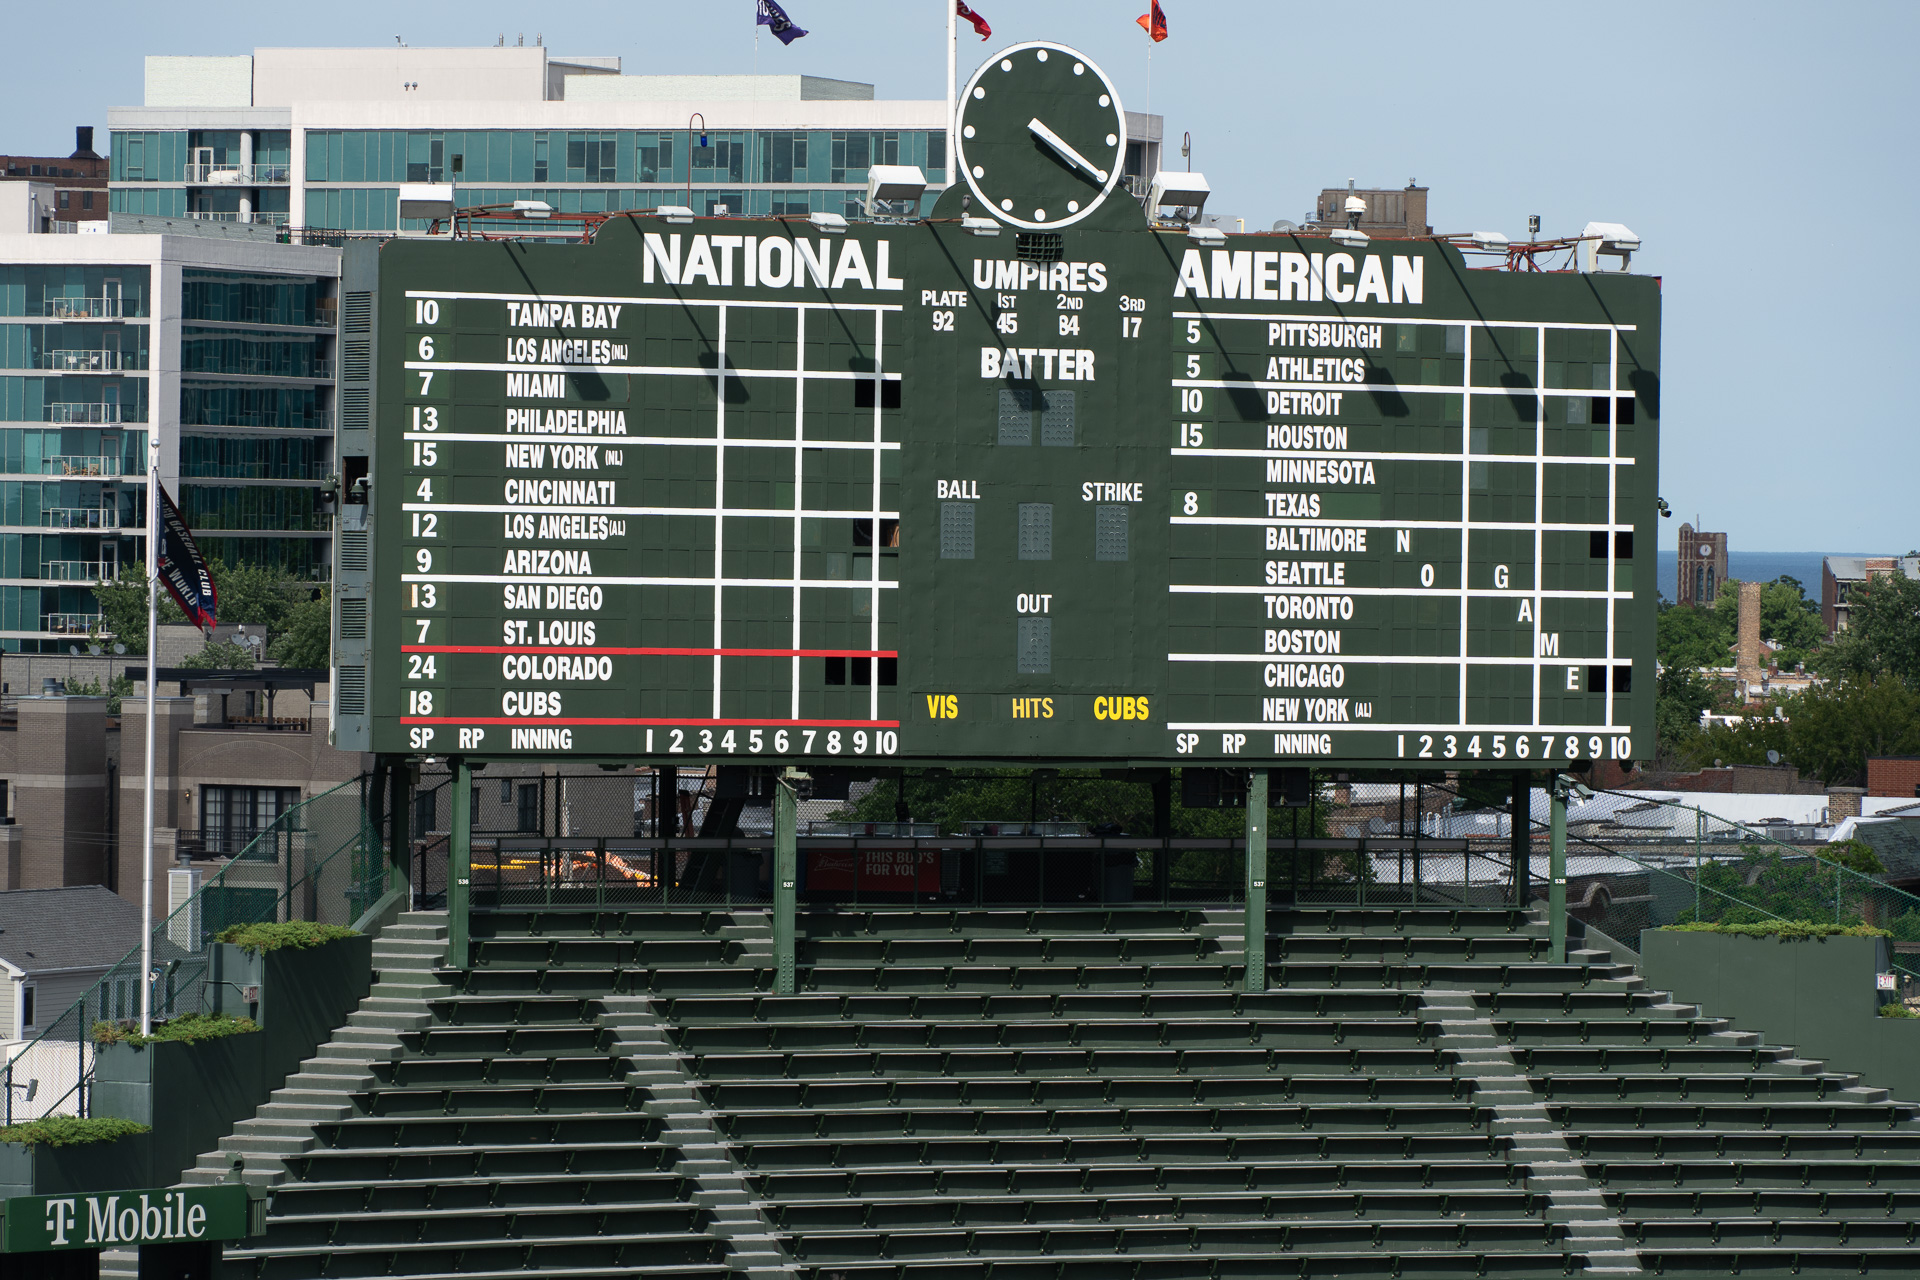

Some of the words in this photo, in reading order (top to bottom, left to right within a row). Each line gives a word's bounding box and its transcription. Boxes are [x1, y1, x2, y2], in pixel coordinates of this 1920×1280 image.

[643, 234, 904, 291] NATIONAL
[973, 258, 1108, 293] UMPIRES
[1174, 249, 1424, 305] AMERICAN
[921, 289, 968, 308] PLATE
[997, 291, 1017, 309] 1ST
[1056, 293, 1084, 310] 2ND
[1118, 294, 1146, 312] 3RD
[415, 299, 440, 325] 10
[506, 301, 577, 329] TAMPA
[581, 303, 622, 329] BAY
[932, 310, 955, 332] 92
[996, 312, 1018, 334] 45
[1058, 314, 1081, 336] 84
[1122, 316, 1143, 339] 17
[1186, 319, 1202, 344] 5
[1268, 322, 1383, 349] PITTSBURGH
[418, 335, 435, 361] 6
[506, 337, 538, 363] LOS
[539, 338, 611, 365] ANGELES
[980, 346, 1096, 381] BATTER
[1185, 354, 1201, 379] 5
[1265, 356, 1366, 383] ATHLETICS
[418, 371, 434, 396] 7
[506, 372, 566, 399] MIAMI
[1181, 388, 1204, 414] 10
[1267, 390, 1343, 417] DETROIT
[412, 406, 439, 432] 13
[506, 408, 628, 435] PHILADELPHIA
[1180, 422, 1204, 448] 15
[1266, 424, 1348, 451] HOUSTON
[412, 441, 438, 467] 15
[505, 443, 546, 469] NEW
[548, 444, 599, 470] YORK
[1266, 458, 1376, 485] MINNESOTA
[416, 477, 434, 502] 4
[504, 478, 616, 505] CINCINNATI
[937, 479, 981, 500] BALL
[1081, 481, 1143, 502] STRIKE
[1183, 491, 1199, 516] 8
[1264, 492, 1321, 518] TEXAS
[411, 512, 438, 538] 12
[504, 513, 535, 540] LOS
[537, 514, 609, 541] ANGELES
[1265, 526, 1368, 553] BALTIMORE
[1396, 529, 1411, 553] N
[415, 548, 433, 573] 9
[502, 549, 593, 575] ARIZONA
[1265, 560, 1346, 586] SEATTLE
[197, 568, 212, 597] CLUB
[1494, 564, 1510, 589] G
[410, 583, 437, 609] 13
[503, 583, 541, 610] SAN
[545, 585, 603, 611] DIEGO
[1016, 592, 1053, 614] OUT
[1263, 594, 1354, 621] TORONTO
[1517, 598, 1534, 623] A
[415, 618, 431, 644] 7
[503, 619, 533, 646] ST.
[538, 619, 596, 646] LOUIS
[1264, 628, 1341, 654] BOSTON
[1540, 632, 1559, 657] M
[407, 654, 437, 680] 24
[502, 654, 613, 682] COLORADO
[1263, 662, 1345, 689] CHICAGO
[1566, 666, 1580, 691] E
[409, 690, 434, 716] 18
[501, 690, 562, 717] CUBS
[926, 694, 959, 720] VIS
[1012, 696, 1054, 719] HITS
[1093, 695, 1150, 721] CUBS
[1262, 697, 1301, 722] NEW
[1303, 697, 1350, 723] YORK
[409, 727, 435, 749] SP
[458, 727, 485, 750] RP
[511, 728, 573, 750] INNING
[645, 728, 654, 753] 1
[668, 728, 684, 753] 2
[697, 728, 714, 754] 3
[720, 729, 737, 754] 4
[748, 729, 764, 754] 5
[774, 729, 790, 754] 6
[802, 729, 817, 754] 7
[826, 730, 842, 755] 8
[852, 730, 868, 755] 9
[875, 730, 898, 756] 10
[1176, 732, 1200, 754] SP
[1222, 733, 1247, 754] RP
[1274, 733, 1332, 755] INNING
[1397, 734, 1405, 758] 1
[1418, 734, 1434, 758] 2
[1442, 734, 1458, 759] 3
[1467, 734, 1483, 759] 4
[1491, 734, 1507, 759] 5
[1515, 734, 1530, 759] 6
[1541, 735, 1555, 759] 7
[1564, 735, 1580, 760] 8
[1588, 735, 1604, 760] 9
[1610, 735, 1632, 760] 10
[864, 851, 893, 864] THIS
[865, 863, 890, 876] FOR
[1879, 976, 1893, 987] EXIT
[84, 1192, 207, 1243] Mobile
